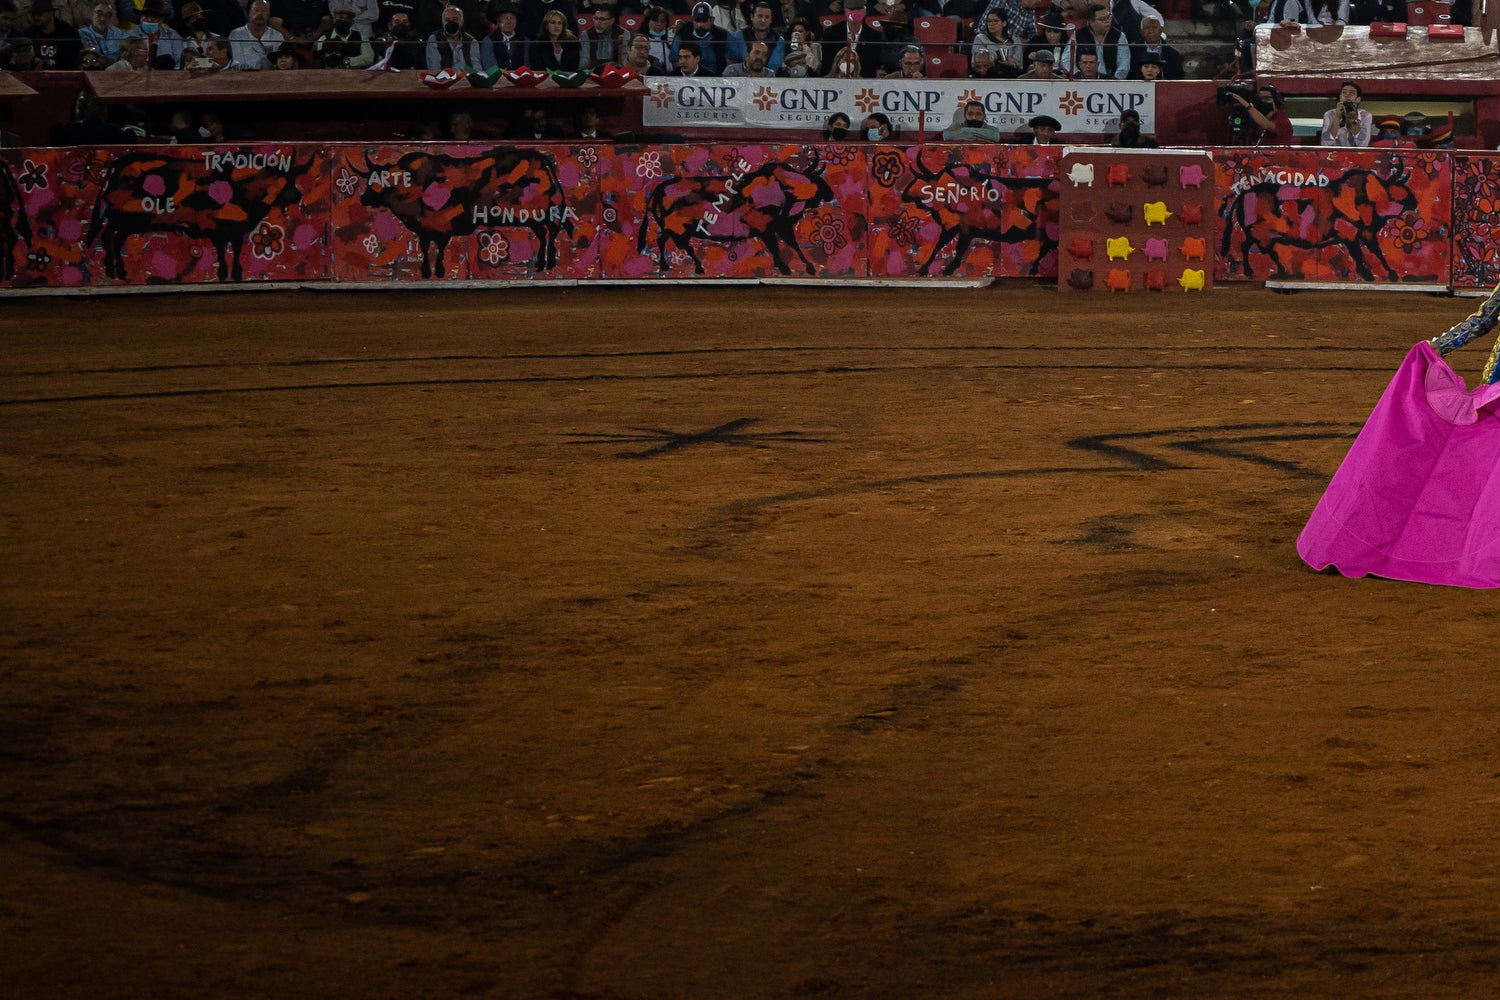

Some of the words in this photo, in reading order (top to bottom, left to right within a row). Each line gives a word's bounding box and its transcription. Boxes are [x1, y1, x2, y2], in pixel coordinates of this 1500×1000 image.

[677, 85, 737, 108] GNP
[780, 88, 839, 110] GNP
[882, 90, 941, 112] GNP
[984, 91, 1043, 114] GNP
[1086, 92, 1145, 114] GNP
[676, 111, 737, 120] SEGUROS
[779, 113, 830, 122] SEGURO
[1086, 118, 1145, 126] SEGUS
[201, 148, 292, 173] TRADICIÓN
[367, 169, 412, 188] ARTE
[1229, 169, 1330, 198] TENACIDAD
[695, 157, 752, 237] TEMPLE
[920, 178, 1000, 204] SEÑORÍO
[141, 196, 176, 215] OLE
[472, 204, 580, 224] HONDURA
